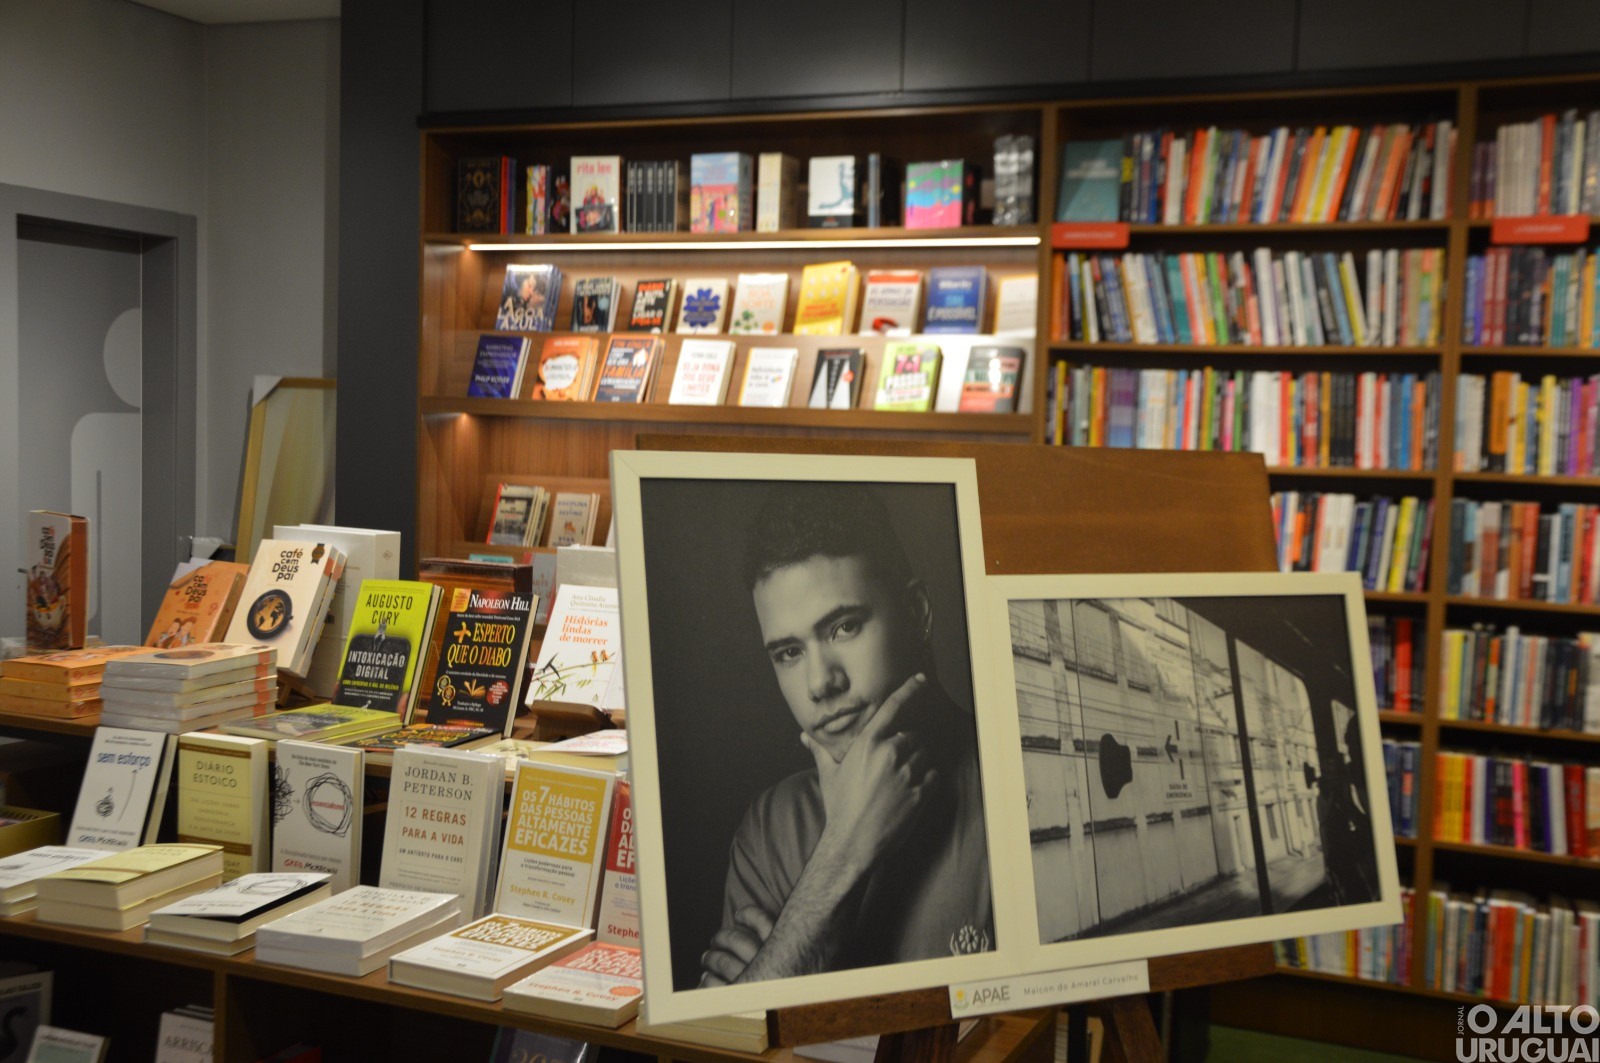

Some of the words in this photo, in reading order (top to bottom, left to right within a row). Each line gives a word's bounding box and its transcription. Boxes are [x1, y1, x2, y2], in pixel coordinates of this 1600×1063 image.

[576, 162, 595, 174] rita
[597, 162, 612, 174] lee
[281, 549, 303, 558] café
[272, 563, 299, 573] Deus
[276, 573, 295, 582] pai
[185, 586, 207, 596] Deus
[366, 594, 414, 611] AUGUSTO
[469, 593, 511, 610] NAPOLEON
[510, 596, 530, 611] HILL
[372, 610, 400, 626] CURY
[565, 615, 608, 627] Histórias
[473, 622, 515, 644] ESPERTO
[562, 624, 592, 635] lindas
[560, 633, 571, 643] de
[574, 635, 608, 645] morrer
[348, 650, 406, 668] INTOXICAÇÃO
[447, 644, 469, 668] QUE
[469, 645, 479, 664] O
[478, 646, 511, 667] DIABO
[355, 664, 389, 680] DIGITAL
[193, 773, 238, 788] ESTOICO
[404, 766, 457, 783] JORDAN
[462, 774, 474, 786] B.
[403, 781, 473, 800] PETERSON
[523, 790, 537, 802] OS
[540, 785, 550, 803] 7
[549, 792, 595, 812] HÁBITOS
[405, 806, 417, 819] 12
[422, 808, 466, 826] REGRAS
[521, 802, 542, 816] DAS
[545, 806, 593, 825] PESSOAS
[623, 808, 632, 820] O
[517, 814, 591, 839] ALTAMENTE
[402, 826, 427, 840] PARA
[430, 831, 437, 841] A
[442, 832, 464, 846] VIDA
[515, 828, 588, 856] EFICAZES
[619, 875, 636, 885] Liçõe
[510, 884, 541, 898] Stephen
[552, 892, 576, 905] Covey
[607, 924, 640, 939] Stephe
[972, 985, 1011, 1005] APAE
[1057, 983, 1068, 992] do
[1071, 979, 1100, 989] Amaral
[1103, 974, 1139, 985] Carvalho
